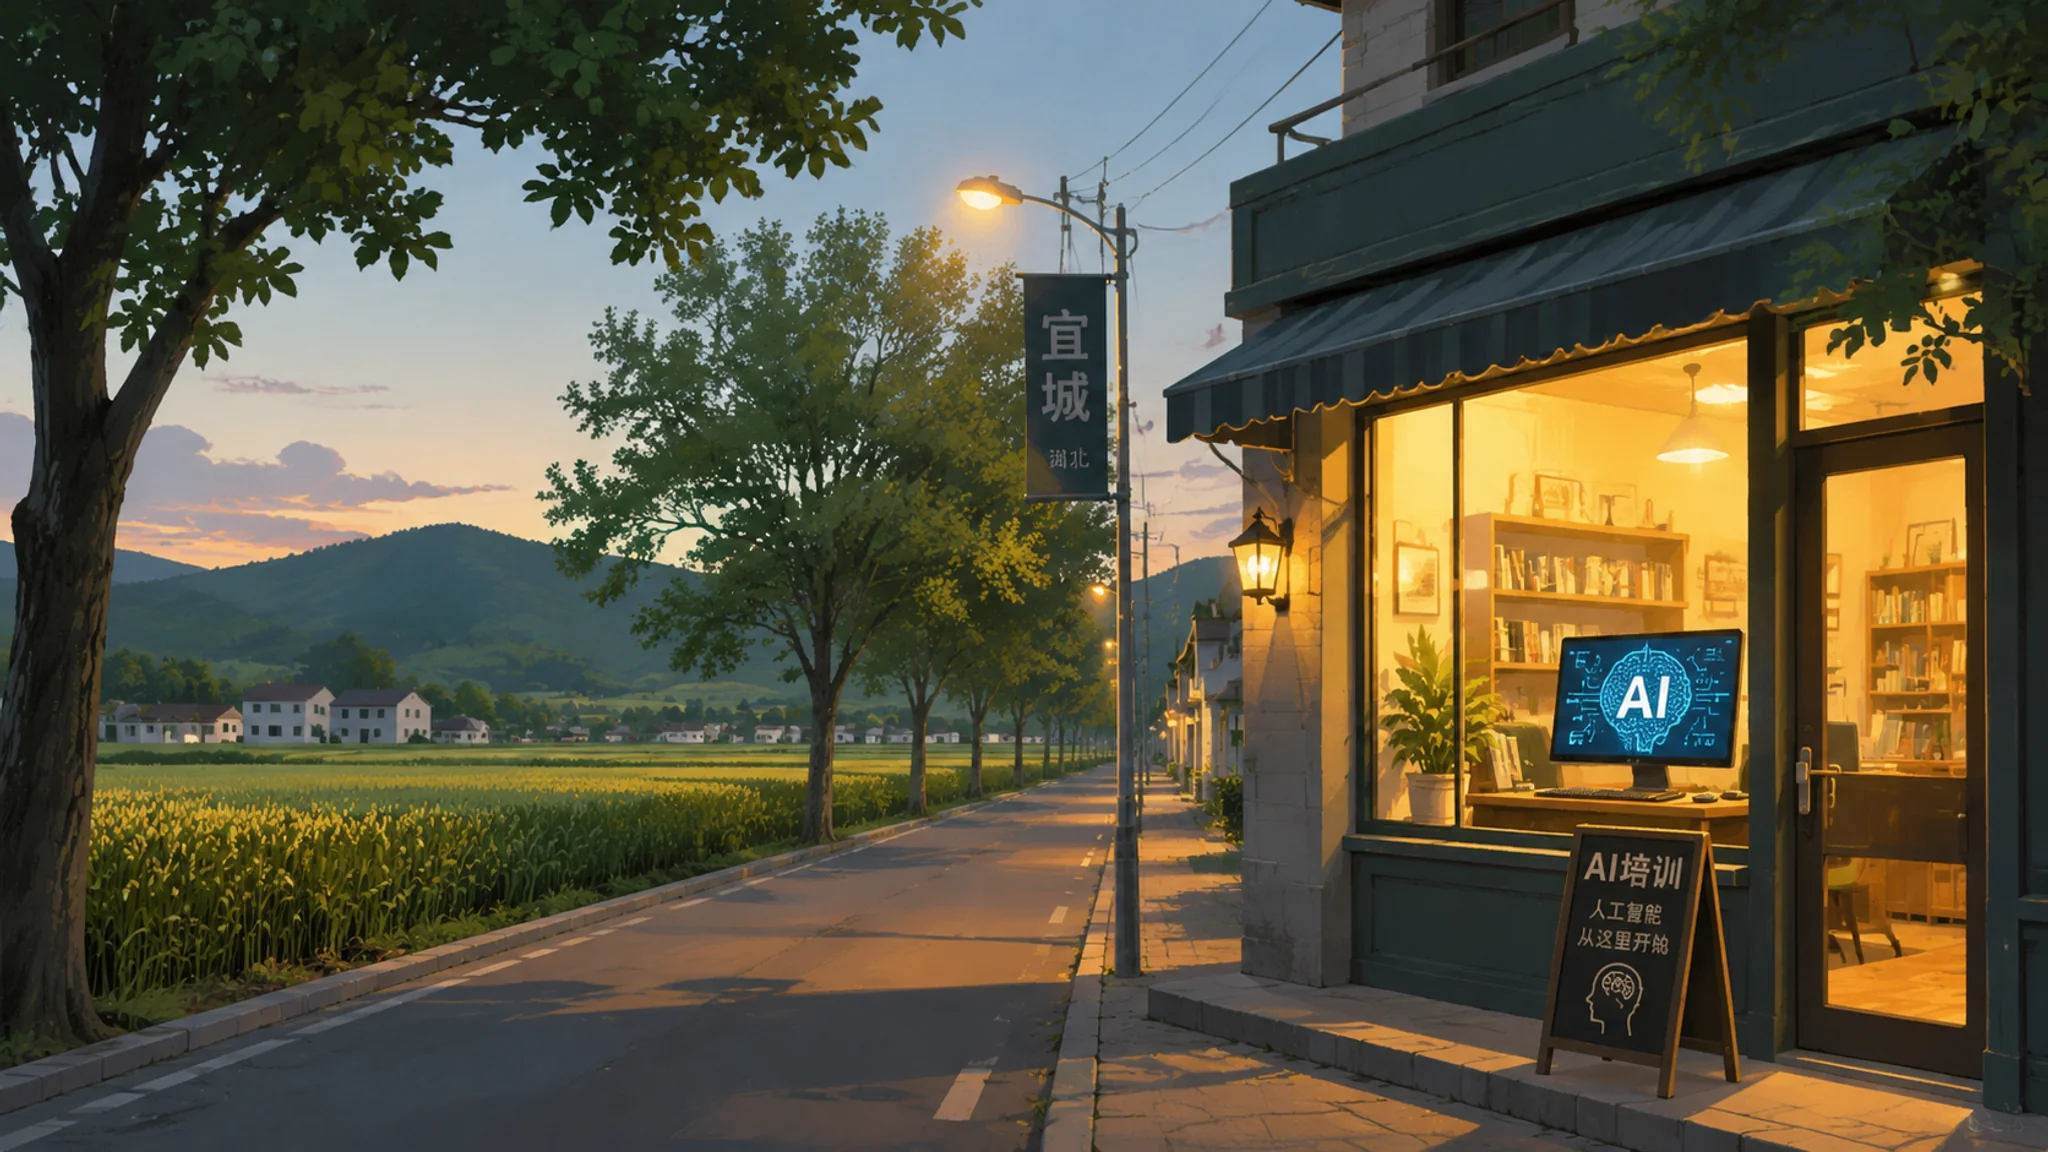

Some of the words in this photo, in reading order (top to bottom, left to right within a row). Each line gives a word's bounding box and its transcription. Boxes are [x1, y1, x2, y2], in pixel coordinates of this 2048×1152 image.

[1041, 308, 1091, 423] 宜城
[1616, 675, 1670, 719] AI
[1583, 851, 1684, 890] AI培训
